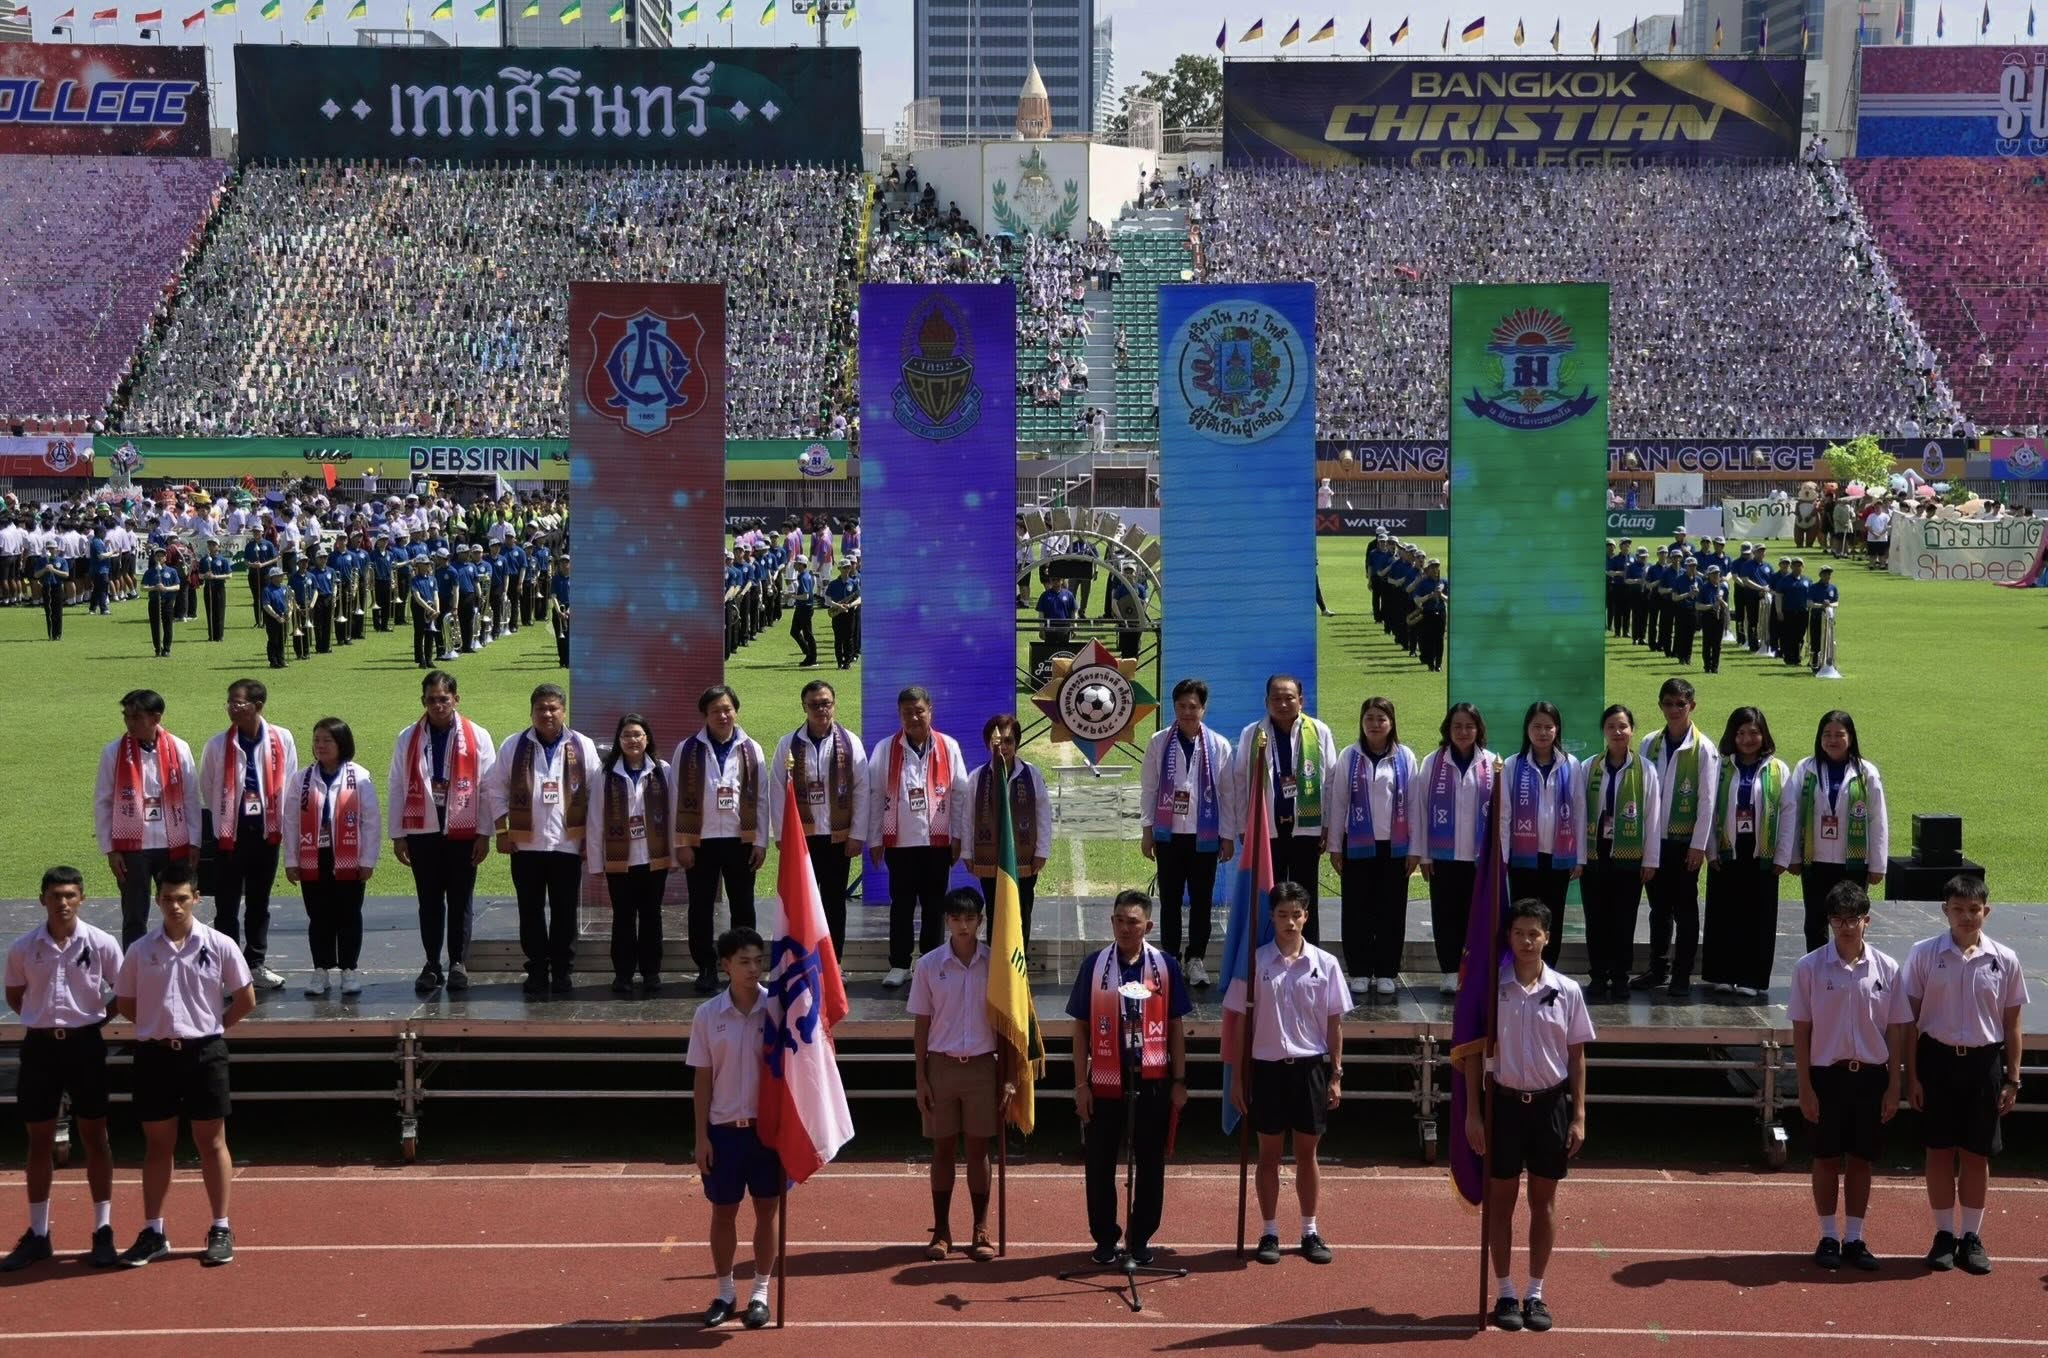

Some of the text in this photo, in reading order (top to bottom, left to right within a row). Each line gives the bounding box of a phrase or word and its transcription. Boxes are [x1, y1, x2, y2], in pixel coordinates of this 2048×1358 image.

[1410, 72, 1637, 98] BANGKOK
[390, 60, 717, 138] เทพศิรินทร์
[1324, 104, 1725, 142] CHRISTIAN
[409, 446, 540, 472] DEBSIRIN
[1360, 447, 1449, 473] BANG
[1677, 446, 1815, 473] COLLEGE
[1344, 518, 1408, 528] WARRIX
[1607, 513, 1657, 531] Chang
[543, 793, 558, 801] VIP
[810, 793, 824, 801] VIP
[249, 803, 258, 812] A
[149, 808, 159, 817] A
[1740, 821, 1750, 830] A
[630, 827, 645, 836] VIP
[1825, 827, 1834, 836] A
[1098, 1039, 1110, 1048] AC
